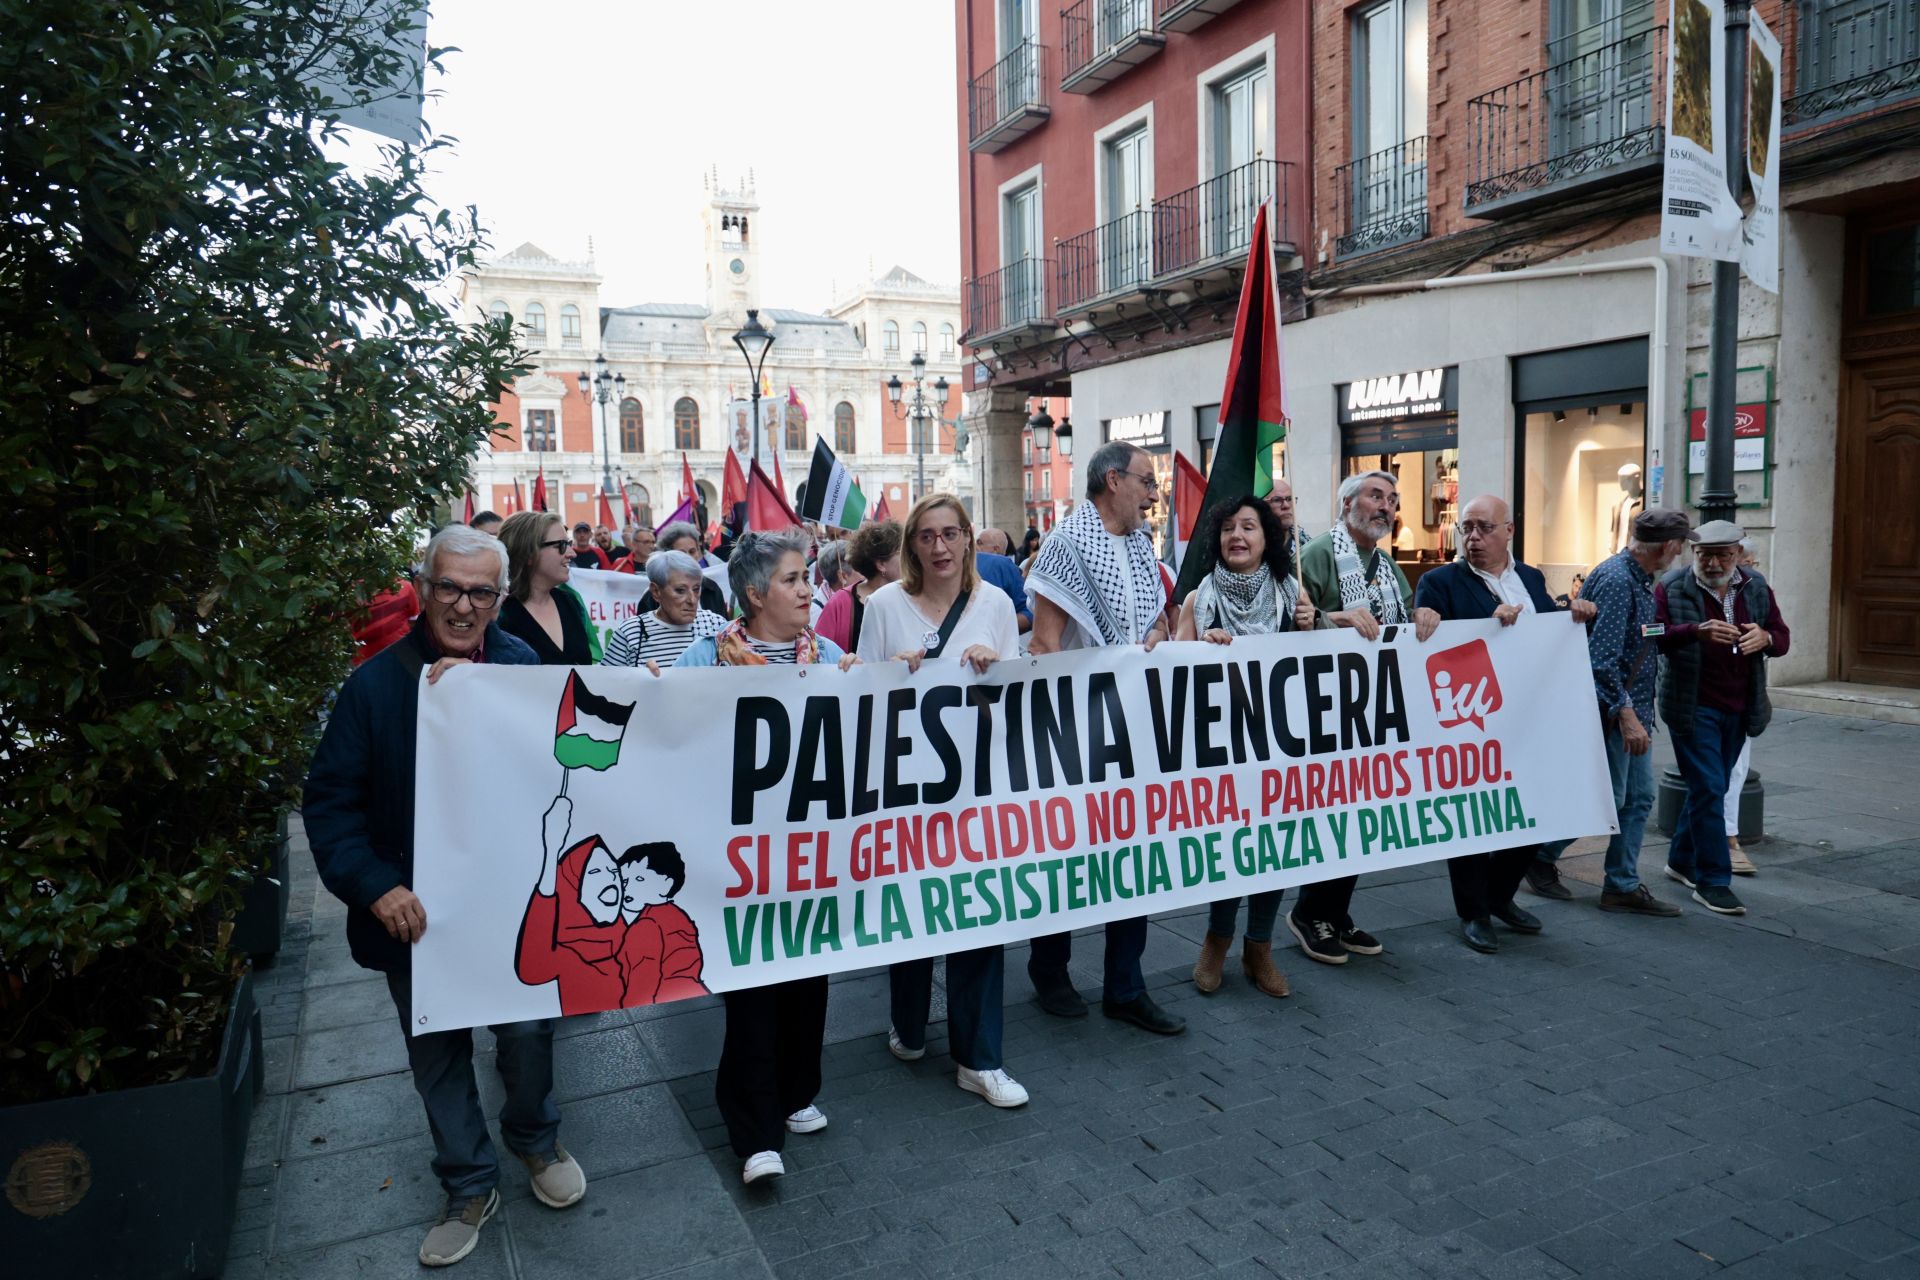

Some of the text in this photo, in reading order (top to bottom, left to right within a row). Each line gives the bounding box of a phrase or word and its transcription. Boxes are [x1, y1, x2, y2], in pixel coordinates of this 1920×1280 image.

[1411, 402, 1442, 414] uomo
[590, 602, 606, 620] EL
[731, 625, 1411, 826] PALESTINA VENCERÁ
[1434, 670, 1494, 721] iu
[725, 738, 1513, 899] SI EL GENOCIDIO NO PARA, PARAMOS TODO.
[723, 785, 1537, 967] VIVA LA RESISTENCIA DE GAZA Y PALESTINA.
